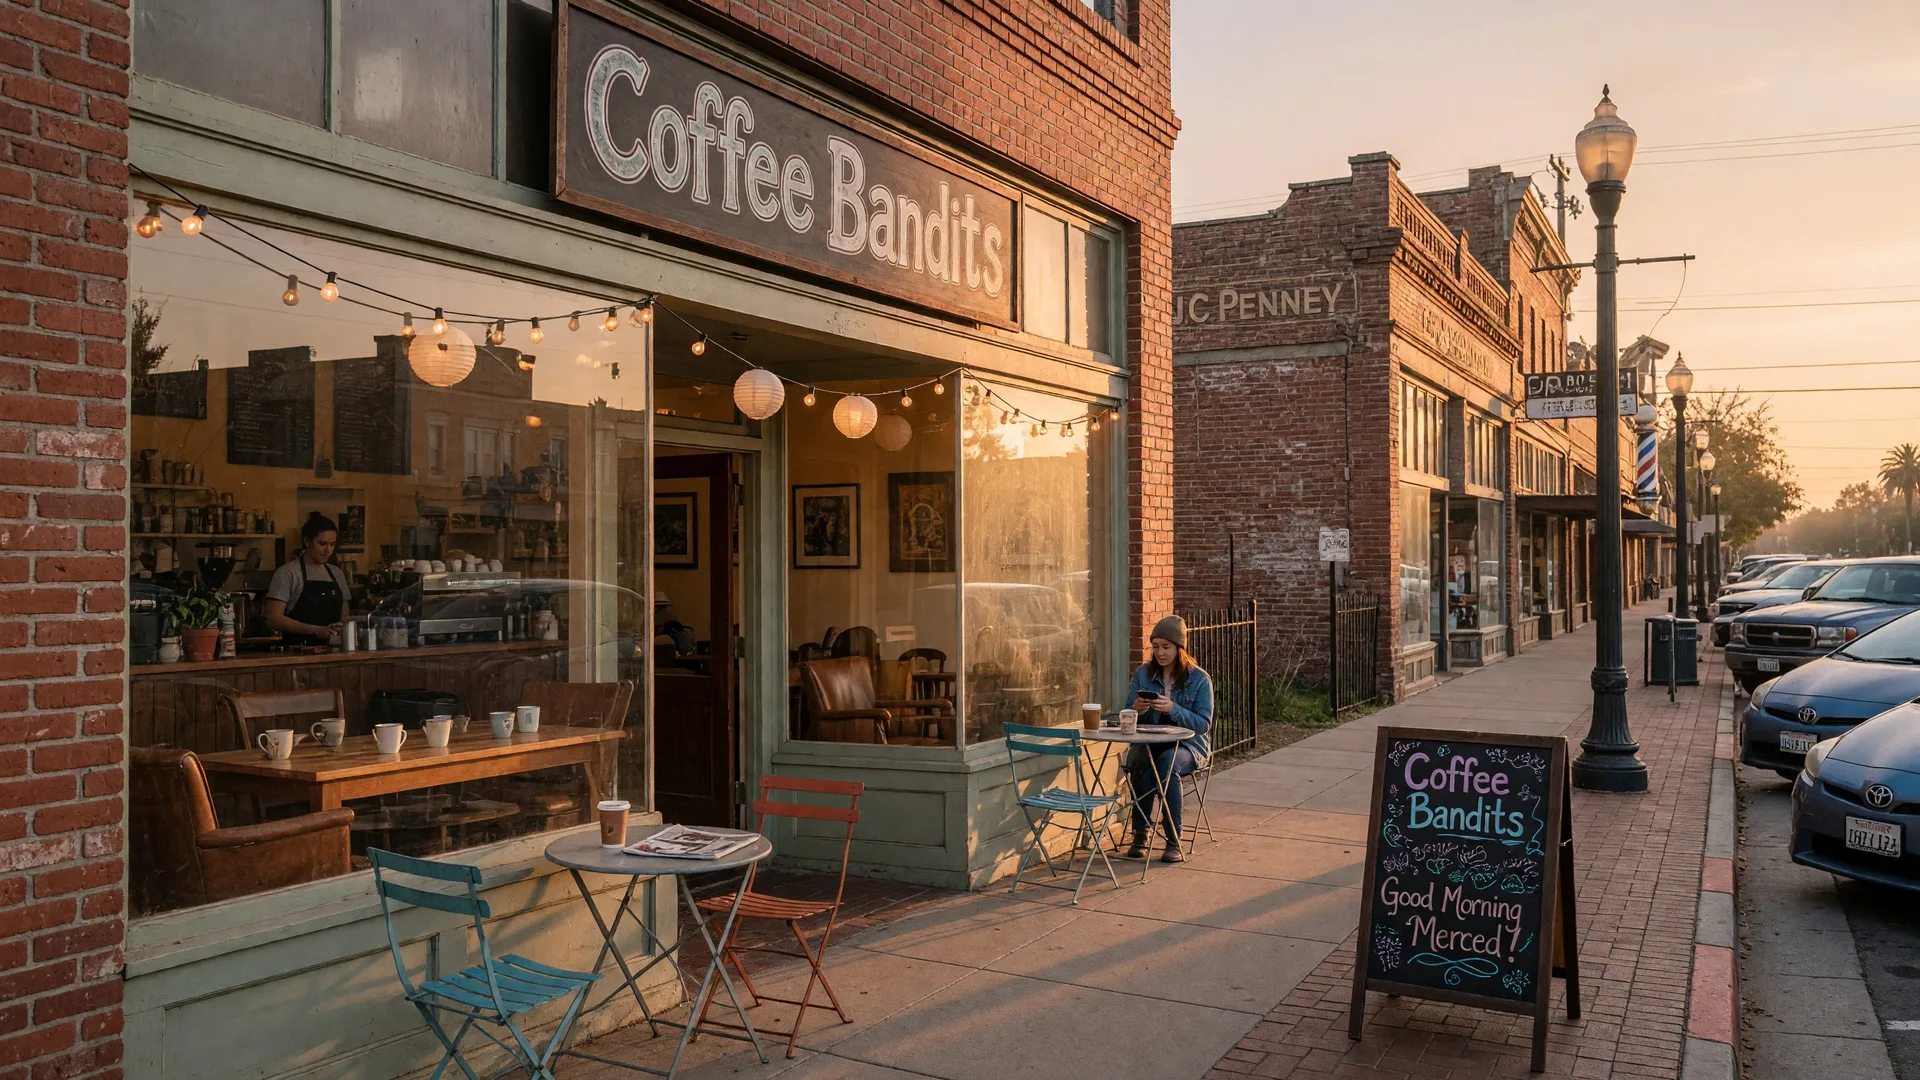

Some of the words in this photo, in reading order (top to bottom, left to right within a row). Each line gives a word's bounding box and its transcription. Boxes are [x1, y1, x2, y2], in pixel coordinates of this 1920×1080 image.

[584, 44, 814, 233] Coffee
[827, 135, 1003, 297] Bandits
[1219, 282, 1343, 321] PENNEY
[1404, 752, 1510, 795] Coffee
[1406, 791, 1524, 837] Bandits
[1381, 876, 1434, 916] Good
[1441, 885, 1522, 932] Morning
